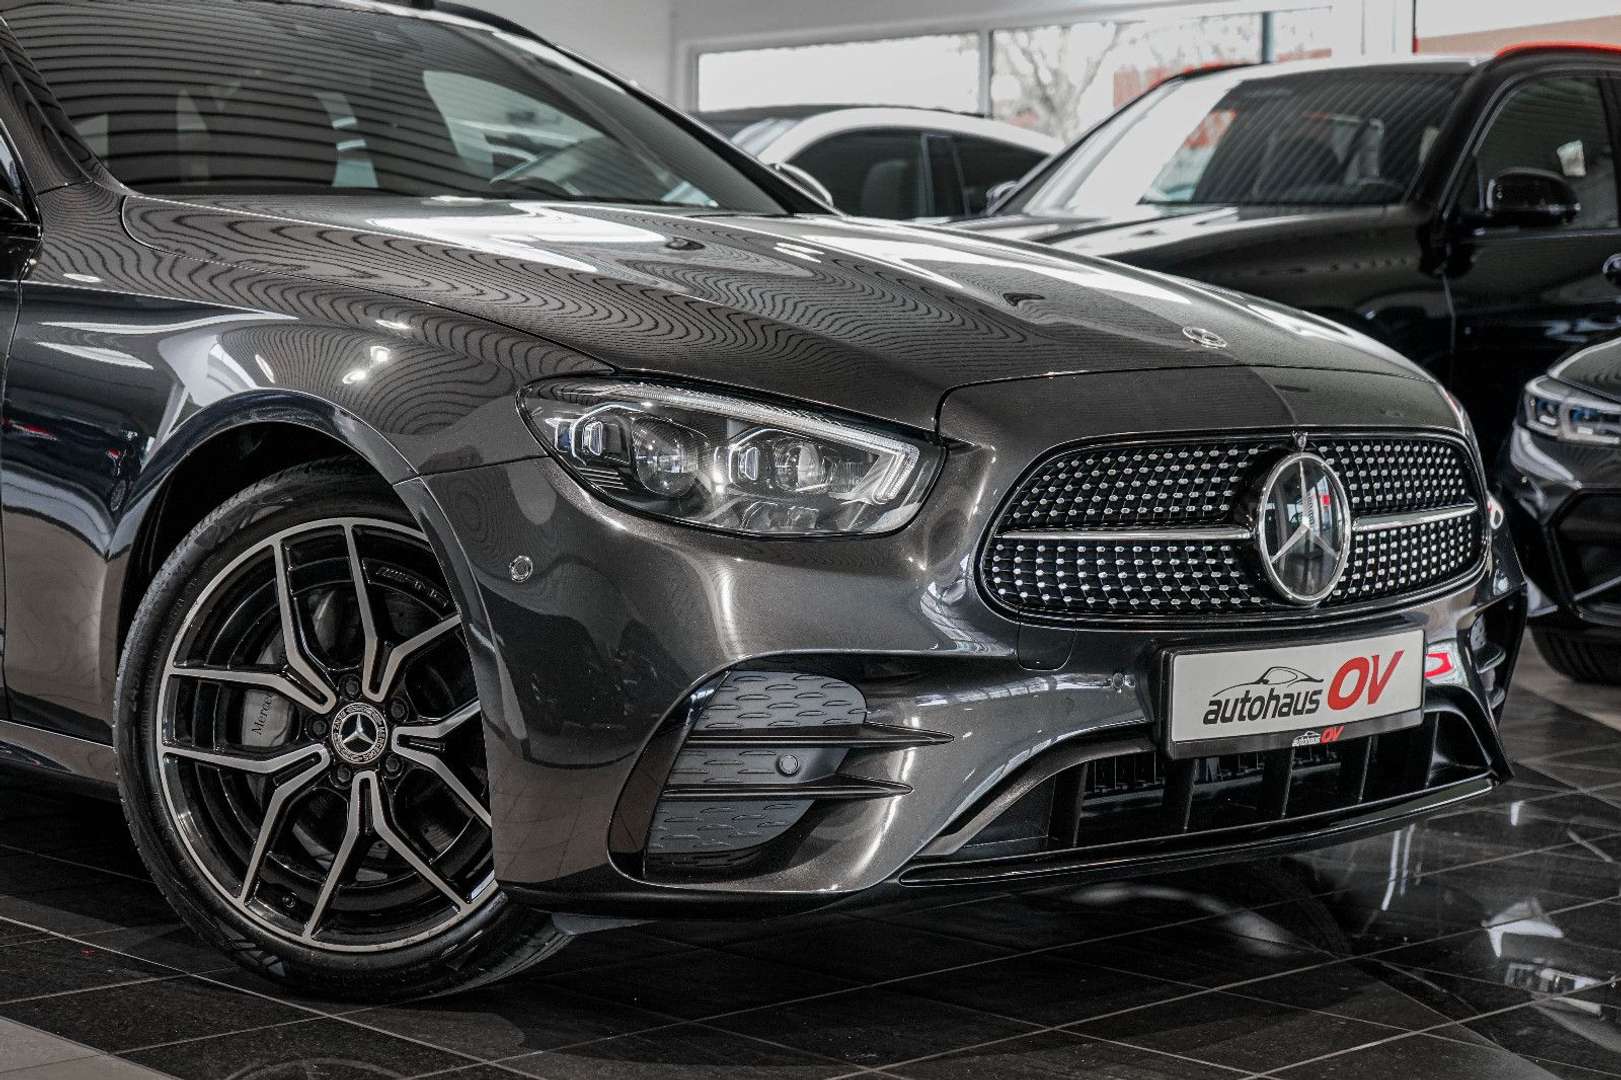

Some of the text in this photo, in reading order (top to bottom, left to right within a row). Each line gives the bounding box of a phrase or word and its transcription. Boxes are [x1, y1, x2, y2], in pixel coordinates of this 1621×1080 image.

[1203, 650, 1405, 725] autohaus OV
[1321, 725, 1345, 744] OV
